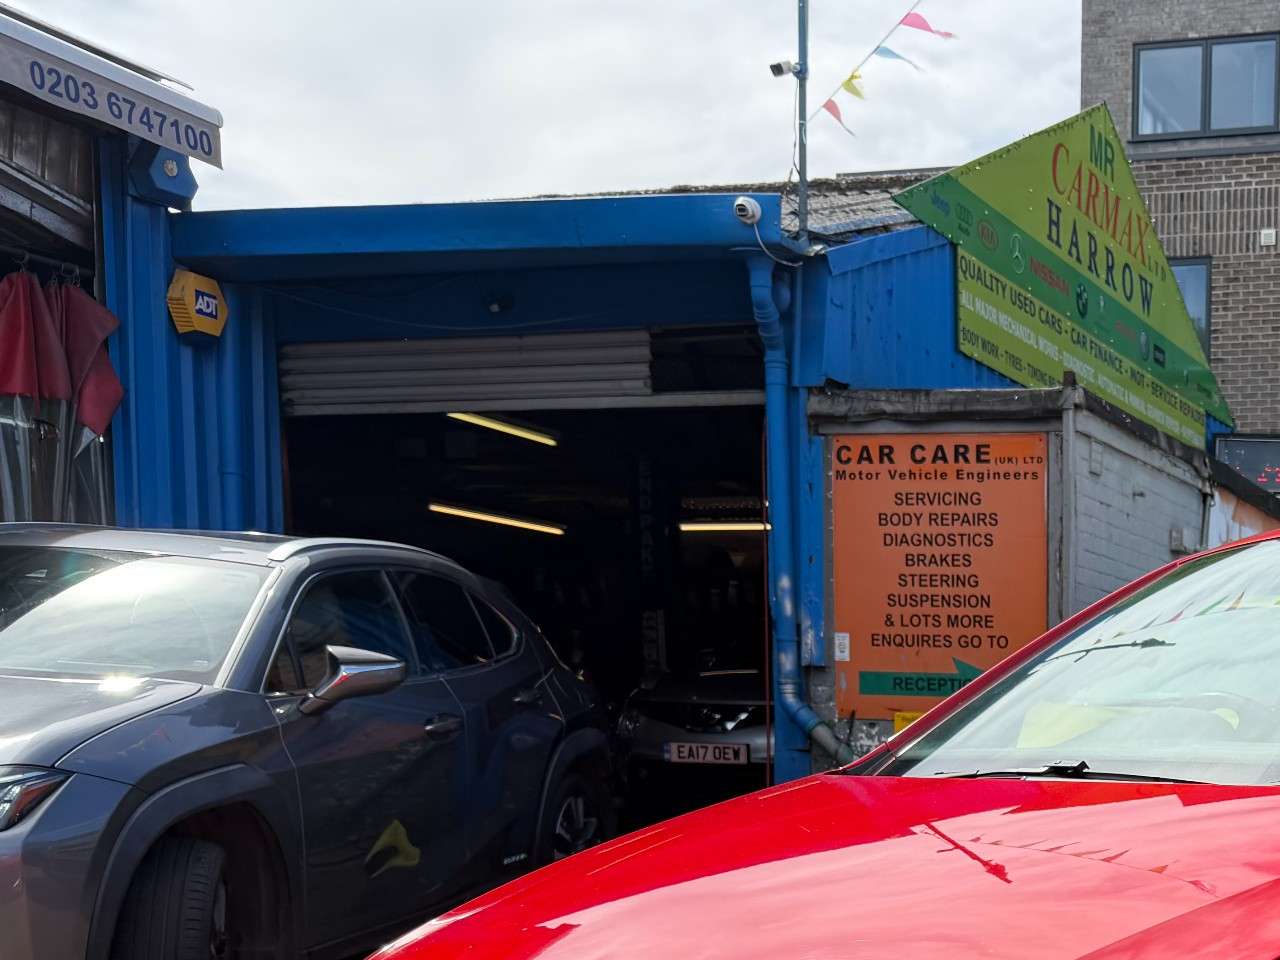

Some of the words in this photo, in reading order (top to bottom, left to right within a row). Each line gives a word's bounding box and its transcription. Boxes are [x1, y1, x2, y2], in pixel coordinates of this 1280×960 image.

[30, 61, 98, 110] 0203
[107, 91, 212, 156] 6747100
[1090, 124, 1114, 182] MR
[1052, 143, 1149, 267] CARMAX
[1148, 255, 1166, 282] LTD
[1047, 196, 1153, 317] HARROW
[195, 295, 217, 316] ADT
[960, 255, 1008, 299] QUALITY
[1010, 286, 1036, 317] USED
[1039, 307, 1062, 335] CARS
[1071, 328, 1088, 351] CAR
[1090, 340, 1123, 375] FINANCE
[836, 445, 895, 465] CAR
[910, 444, 991, 465] CARE
[995, 456, 1018, 465] (UK)
[1023, 456, 1043, 465] LTD
[836, 469, 881, 481] Motor
[888, 469, 948, 481] Vehicle
[956, 469, 1039, 482] Engineers
[894, 492, 982, 506] SERVICING
[878, 512, 923, 527] BODY
[929, 512, 998, 527] REPAIRS
[883, 533, 994, 547] DIAGNOSTICS
[905, 553, 972, 567] BRAKES
[898, 574, 979, 588] STEERING
[887, 593, 991, 608] SUSPENSION
[884, 614, 895, 627] &
[900, 614, 941, 628] LOTS
[947, 615, 994, 628] MORE
[871, 633, 952, 649] ENQUIRES
[958, 635, 982, 649] GO
[987, 635, 1008, 649] TO
[677, 745, 708, 760] EA17
